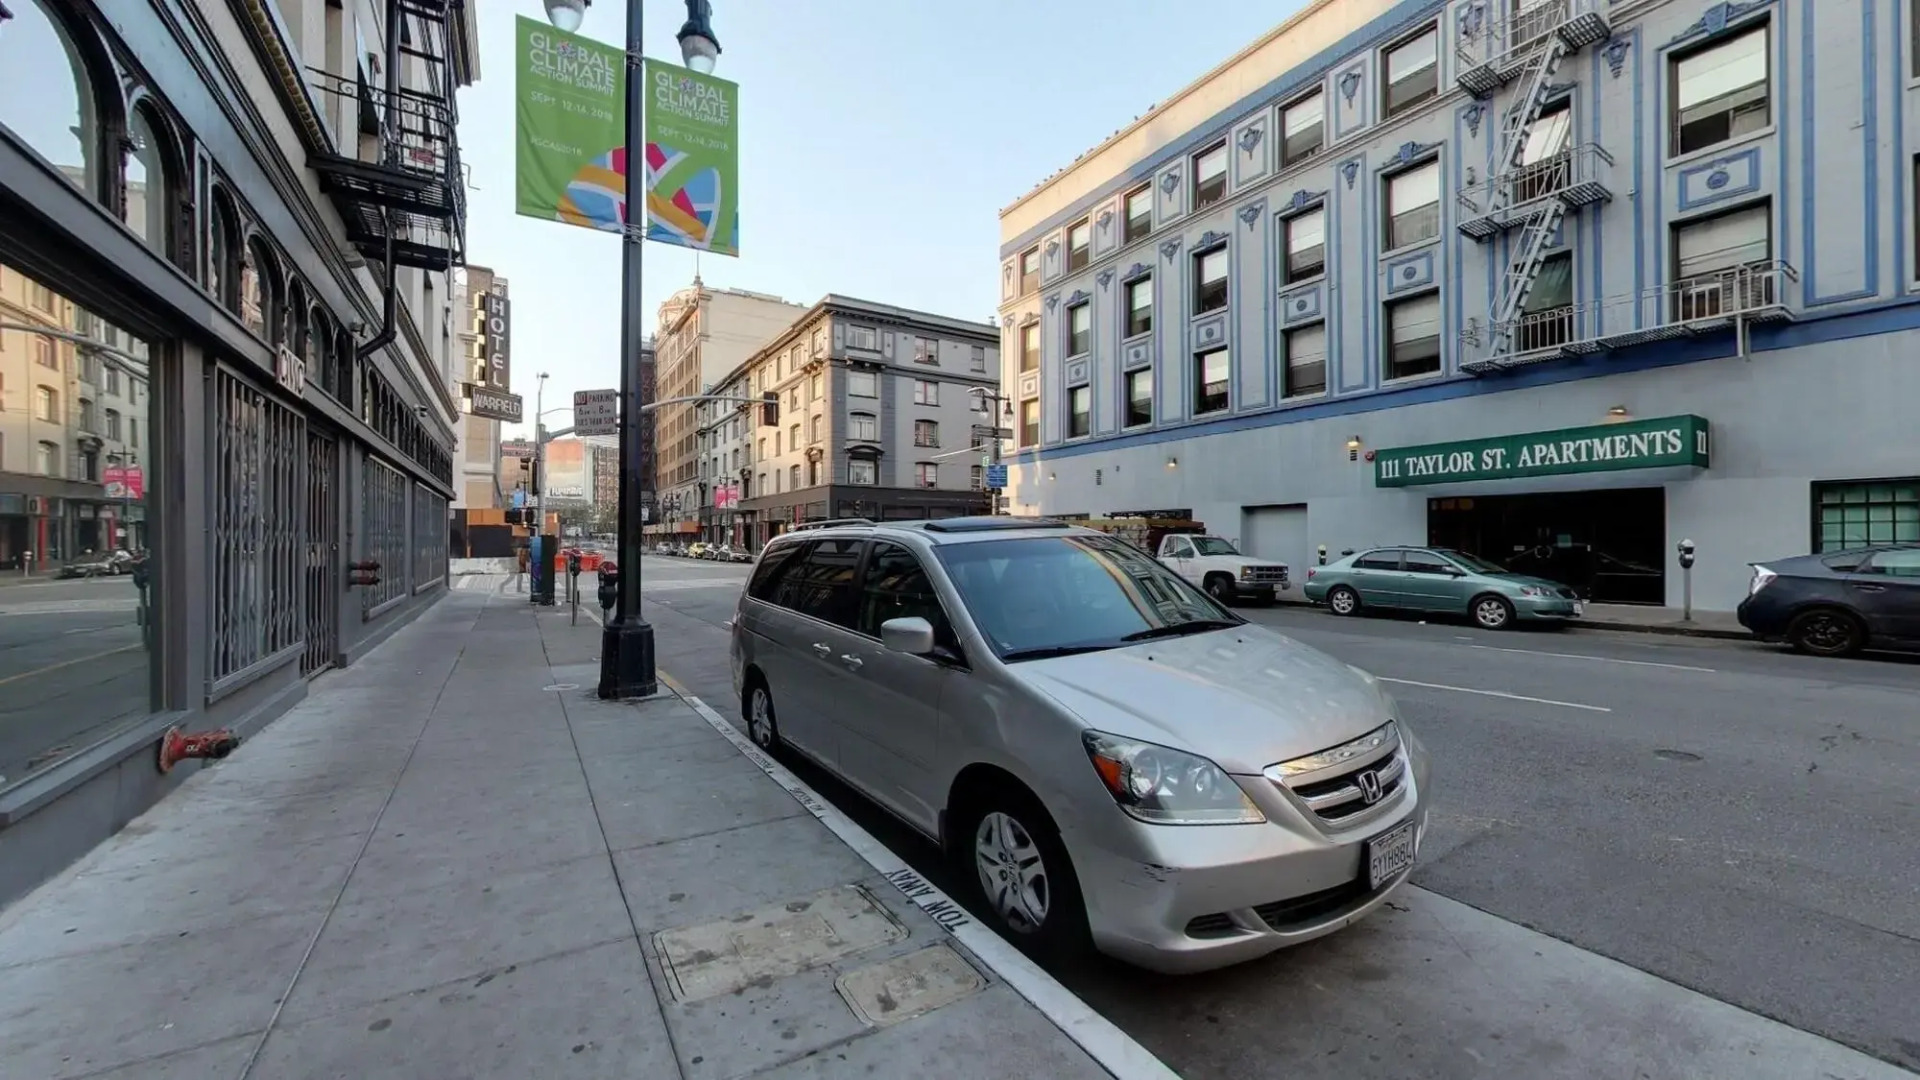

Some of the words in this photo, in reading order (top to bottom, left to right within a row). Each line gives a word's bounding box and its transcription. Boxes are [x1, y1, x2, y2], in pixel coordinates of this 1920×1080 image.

[530, 32, 615, 73] GLOBAL
[530, 49, 615, 88] CLIMATE
[530, 65, 573, 85] ACTION
[576, 78, 615, 97] SUMMIT
[655, 71, 729, 104] GLOBAL
[655, 86, 729, 120] CLIMATE
[656, 102, 692, 119] ACTION
[694, 112, 729, 126] SUMMIT
[491, 298, 504, 387] HOTEL
[473, 393, 520, 415] WARFIELD
[576, 393, 586, 404] NO
[589, 393, 613, 402] PARKING
[1381, 458, 1401, 479] 111
[1405, 451, 1476, 477] TAYLOR
[1481, 447, 1511, 470] ST.
[1517, 428, 1683, 469] APARTMENTS
[882, 867, 936, 899] AWAY
[922, 899, 970, 933] TOW
